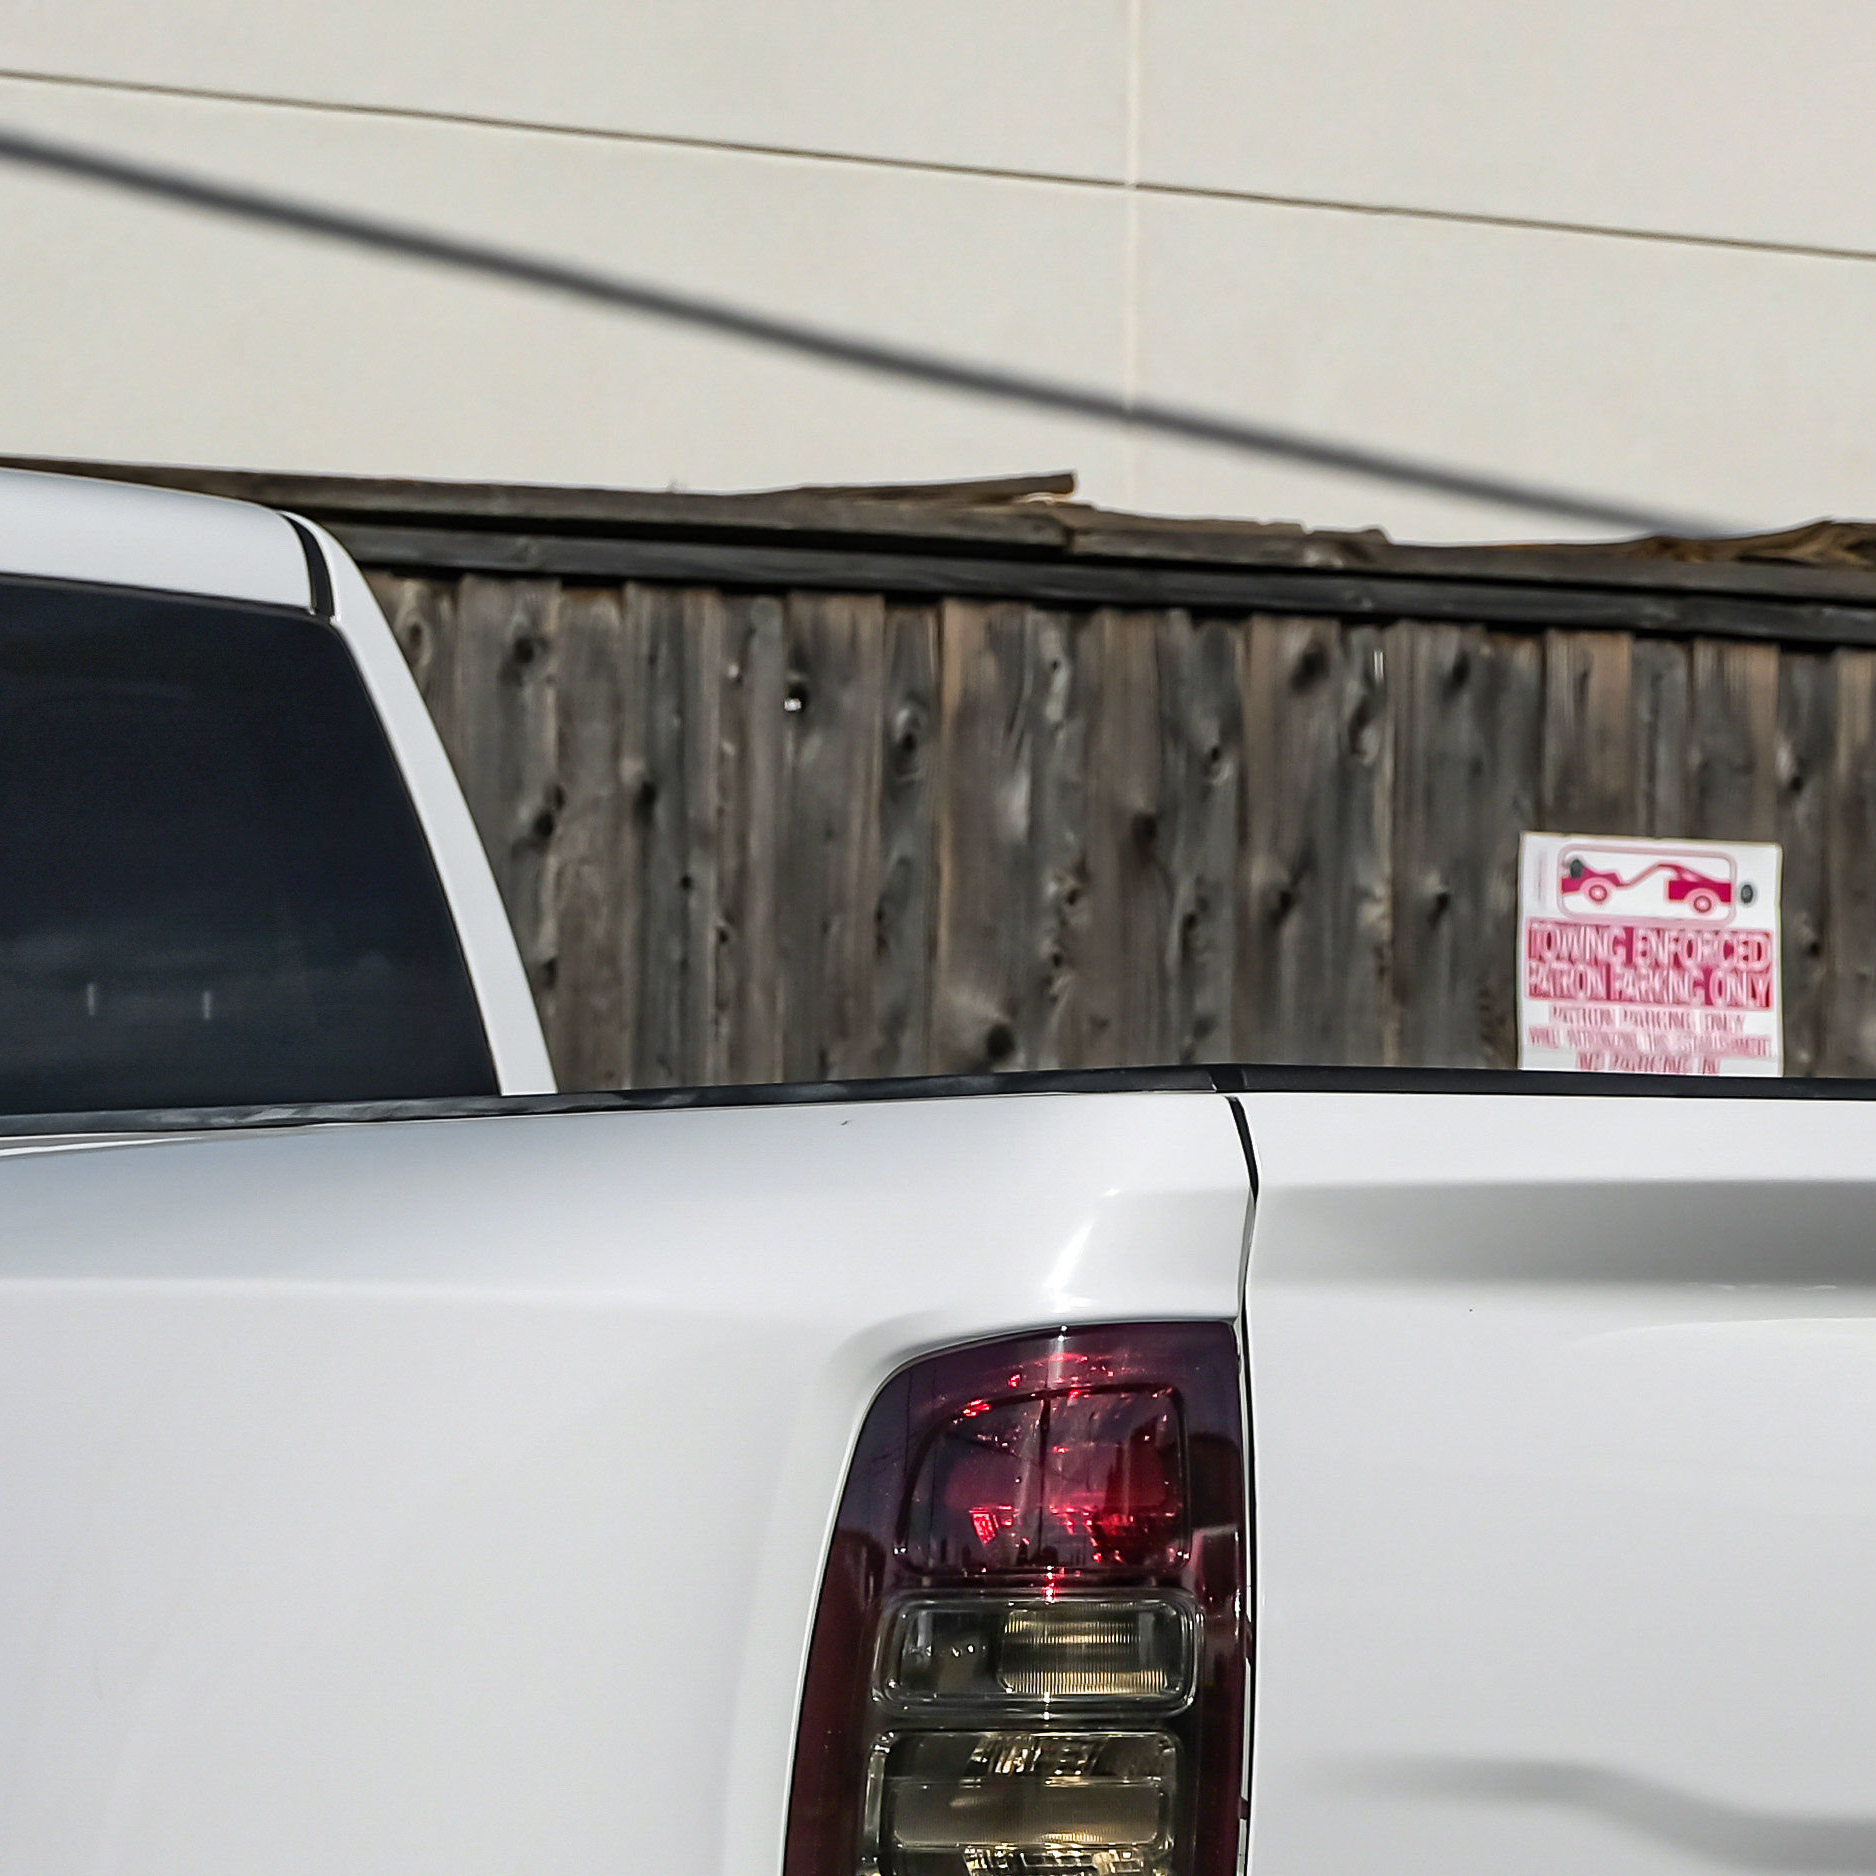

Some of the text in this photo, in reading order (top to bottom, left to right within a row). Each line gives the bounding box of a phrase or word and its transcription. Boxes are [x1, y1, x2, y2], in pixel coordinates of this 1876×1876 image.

[1530, 923, 1771, 971] TOWING ENFORCED
[1530, 963, 1771, 1007] PATRON PARKING ONLY
